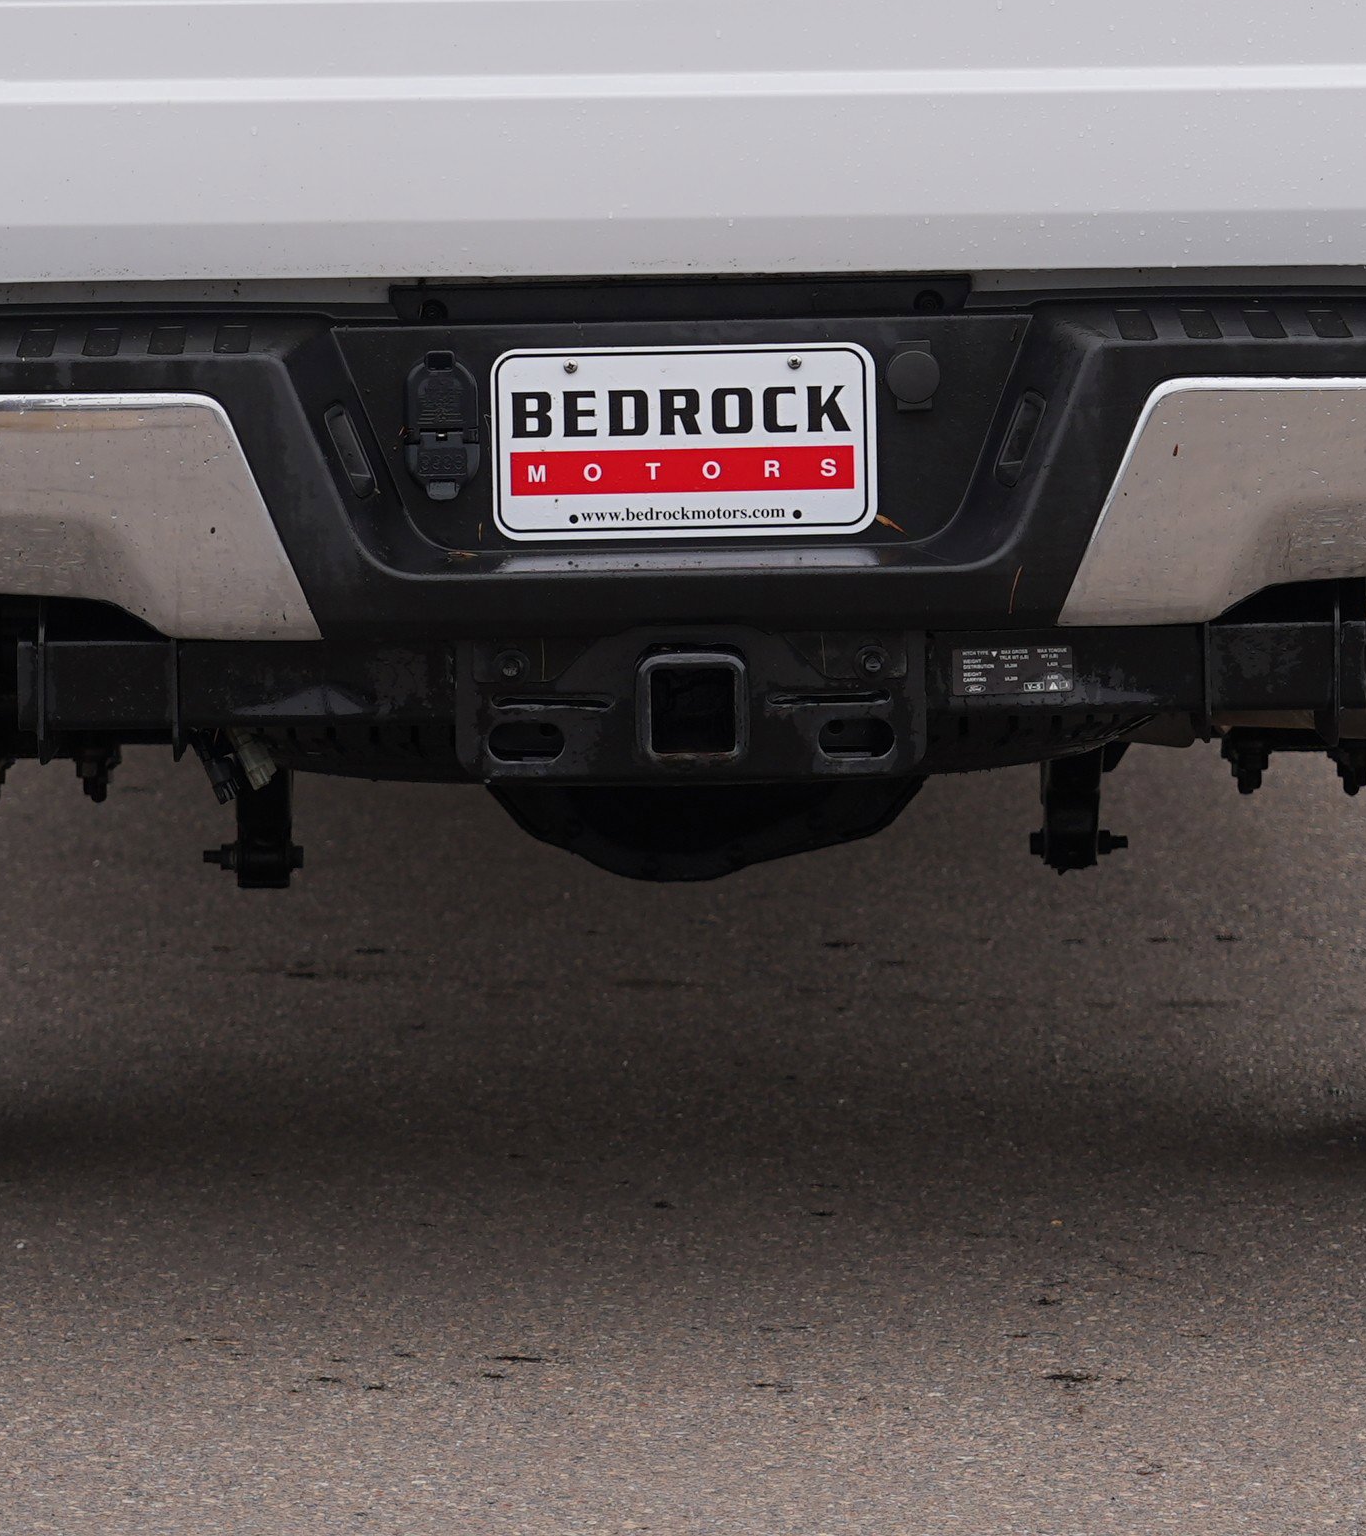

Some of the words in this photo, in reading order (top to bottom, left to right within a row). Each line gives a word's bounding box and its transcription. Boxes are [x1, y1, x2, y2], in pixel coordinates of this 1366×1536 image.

[510, 384, 852, 439] BEDROCK
[527, 457, 838, 484] MOTORS
[580, 505, 786, 523] www.bedrockmotors.com
